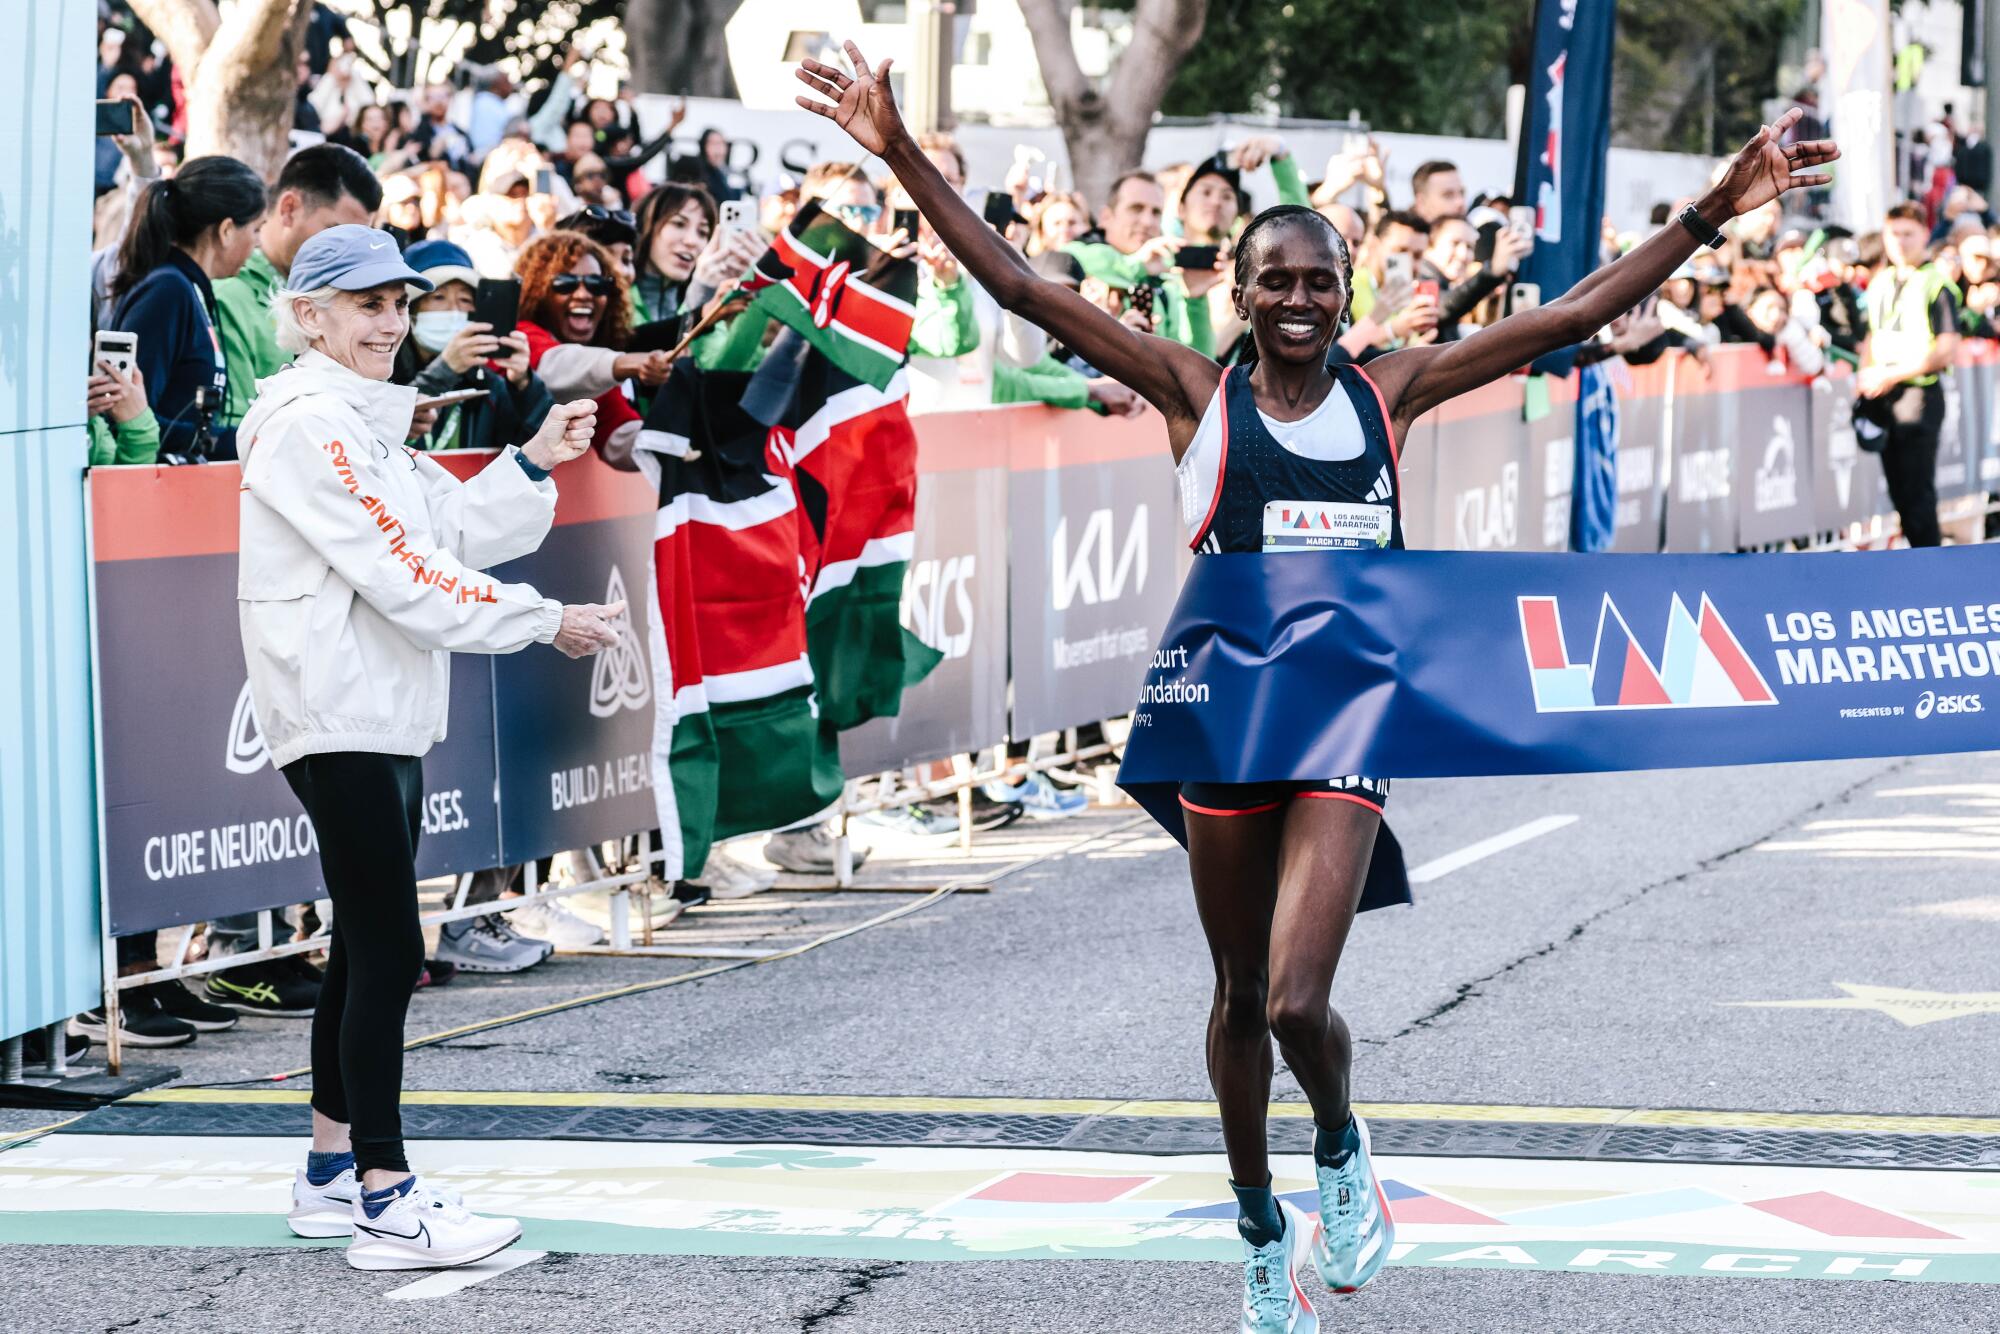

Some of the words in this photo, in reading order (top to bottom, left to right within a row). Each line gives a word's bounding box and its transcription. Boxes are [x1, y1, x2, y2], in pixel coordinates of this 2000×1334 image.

[1333, 520, 1380, 530] MARATHON
[1350, 514, 1380, 522] ANGELES
[1306, 537, 1333, 546] MARCH
[1334, 538, 1343, 547] 17,
[1343, 538, 1359, 547] 2024
[390, 541, 458, 594] FINSH
[456, 584, 498, 605] TH
[1765, 611, 1837, 642] LOS
[1850, 603, 2000, 640] ANGELES
[1840, 706, 1891, 719] PRESENTED
[1893, 706, 1905, 716] BY
[1135, 713, 1153, 727] 1992
[551, 764, 600, 811] BUILD
[602, 760, 616, 798] A
[144, 830, 206, 882] CURE
[210, 814, 320, 871] NEUROLO
[0, 1157, 125, 1168] OS
